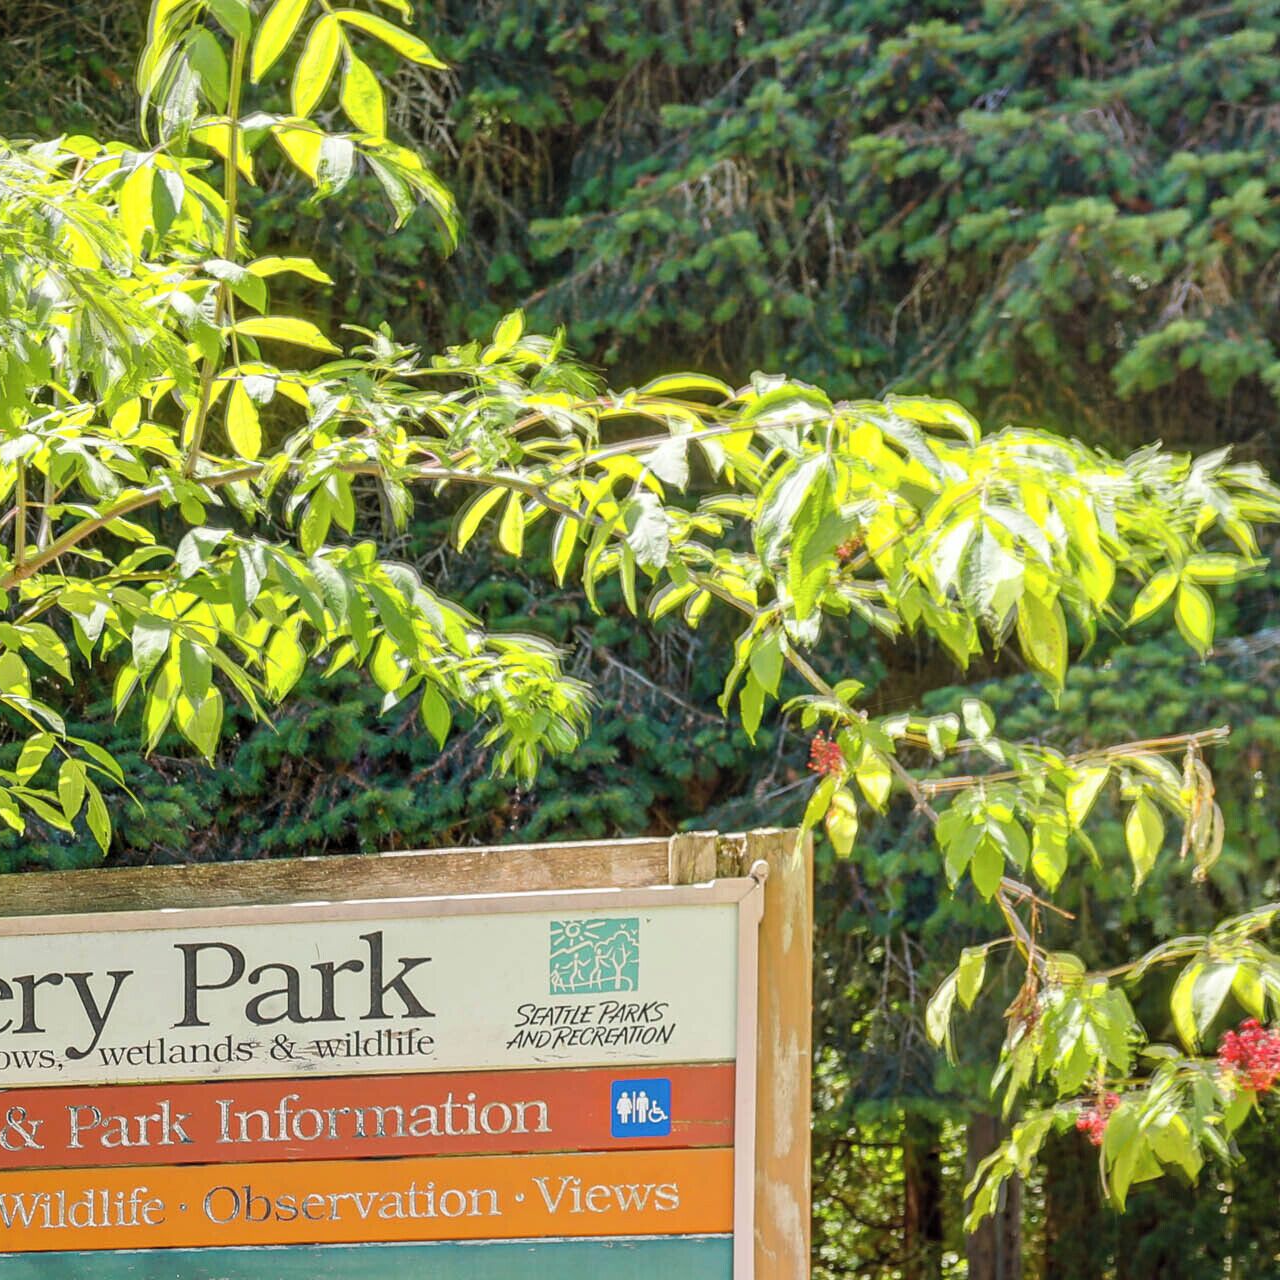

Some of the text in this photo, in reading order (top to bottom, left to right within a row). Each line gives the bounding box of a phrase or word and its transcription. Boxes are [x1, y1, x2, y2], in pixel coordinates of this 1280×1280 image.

[173, 931, 436, 1029] Park
[514, 1000, 669, 1027] SEATTLE PARKS
[99, 1036, 254, 1067] wetlands
[270, 1033, 299, 1062] &
[313, 1028, 436, 1059] wildlife
[506, 1023, 676, 1049] AND RECREATION
[65, 1099, 196, 1148] Park
[215, 1092, 553, 1145] Information
[203, 1181, 503, 1225] Observation
[532, 1175, 682, 1216] Views
